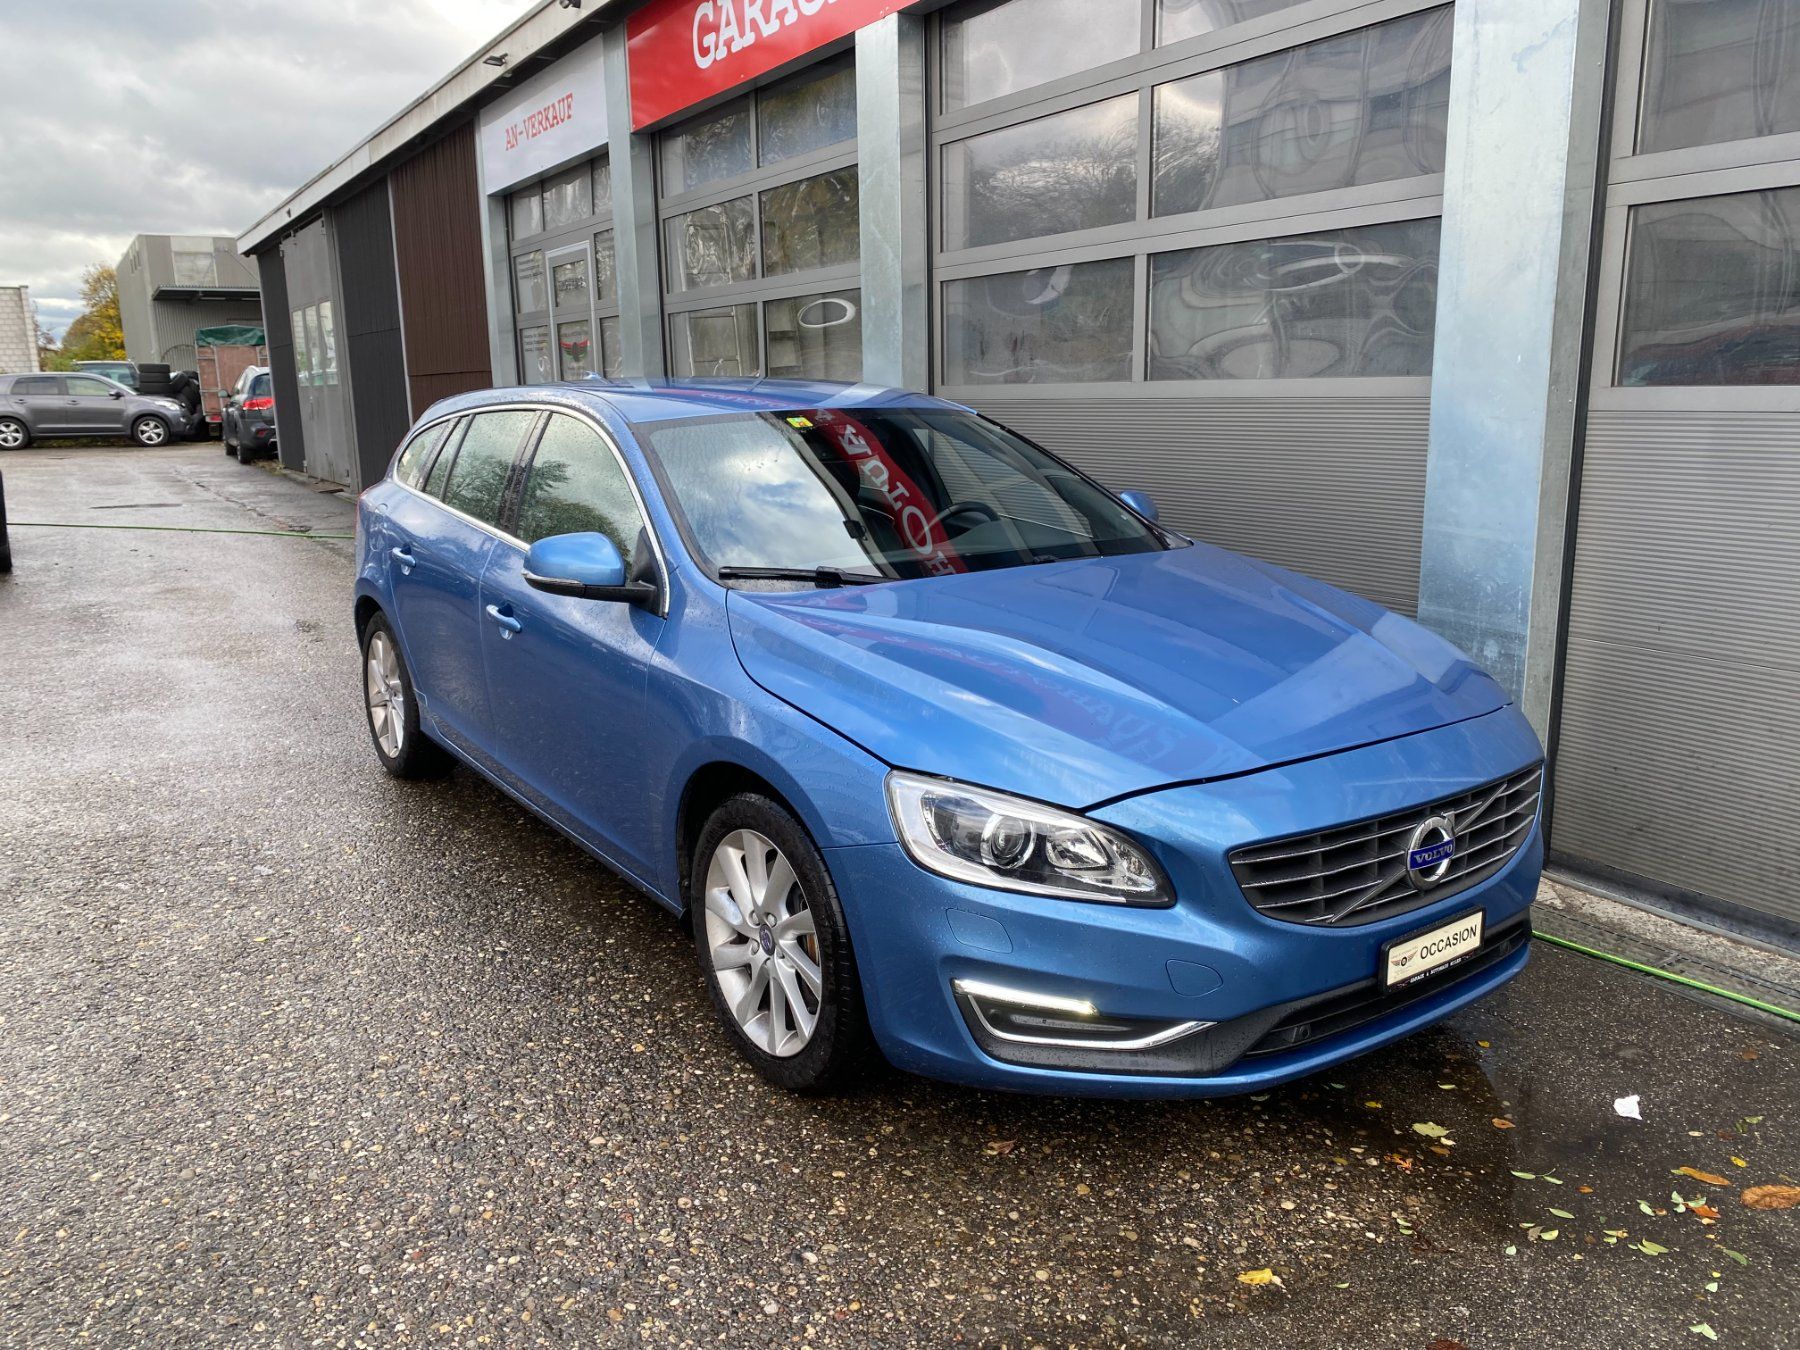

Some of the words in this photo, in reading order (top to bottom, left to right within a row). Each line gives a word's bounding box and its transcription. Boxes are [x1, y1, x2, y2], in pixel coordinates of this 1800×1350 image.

[505, 92, 573, 151] AN-VERKAUF
[1414, 844, 1453, 863] VOLVO
[1420, 924, 1477, 959] OCCASION
